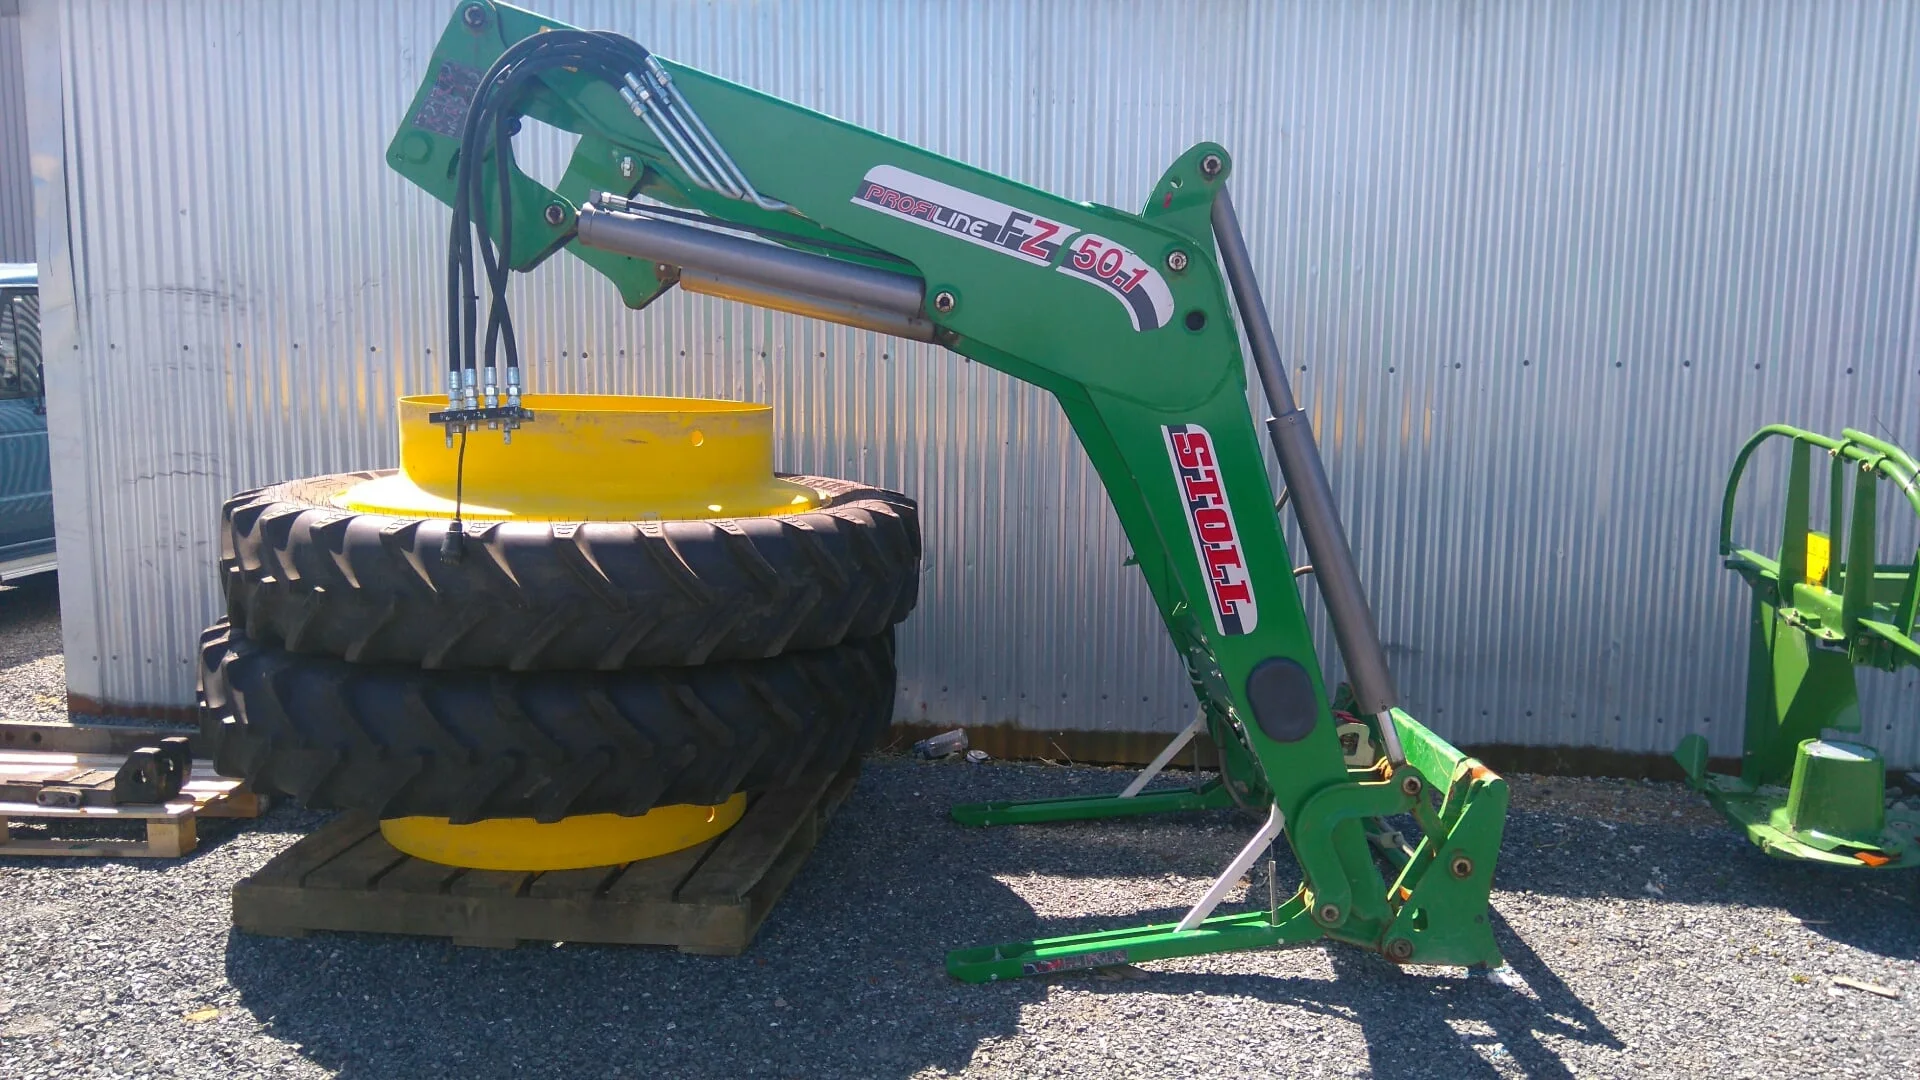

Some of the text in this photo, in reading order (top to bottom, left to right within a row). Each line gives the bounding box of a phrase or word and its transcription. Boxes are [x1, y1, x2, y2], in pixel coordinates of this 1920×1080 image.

[997, 211, 1060, 259] FZ
[1073, 238, 1149, 294] 50.1
[1172, 432, 1252, 615] STOLL
